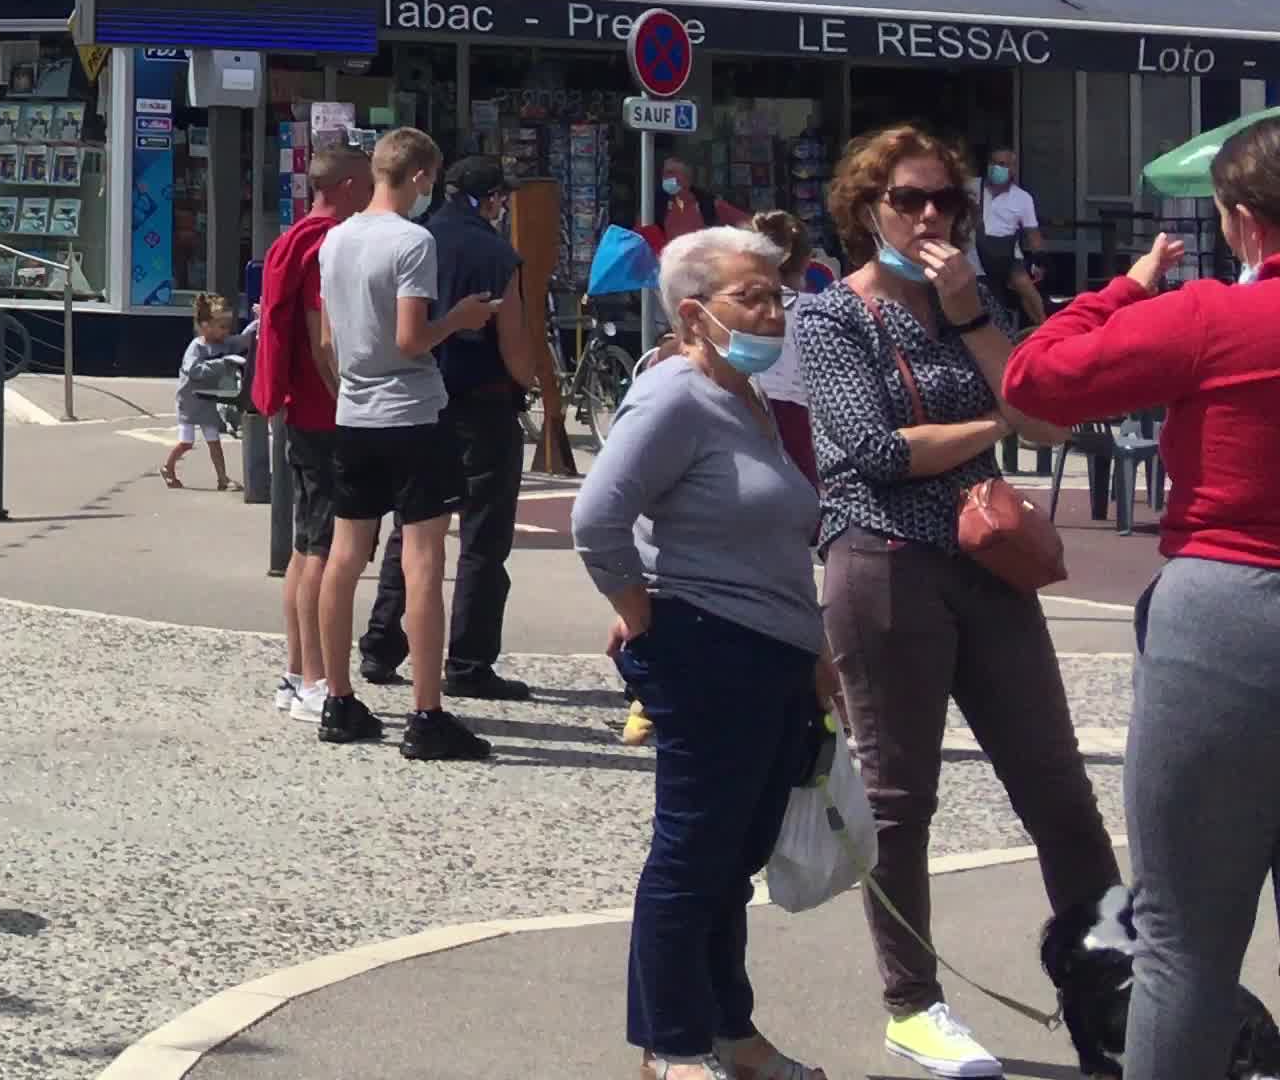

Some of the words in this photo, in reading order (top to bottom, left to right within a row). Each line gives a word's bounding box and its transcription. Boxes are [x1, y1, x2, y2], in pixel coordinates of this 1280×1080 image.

[567, 2, 706, 45] Pree
[798, 16, 849, 54] LE
[877, 21, 1051, 65] RESSAC
[1138, 37, 1216, 73] Loto
[633, 105, 673, 124] SAUF
